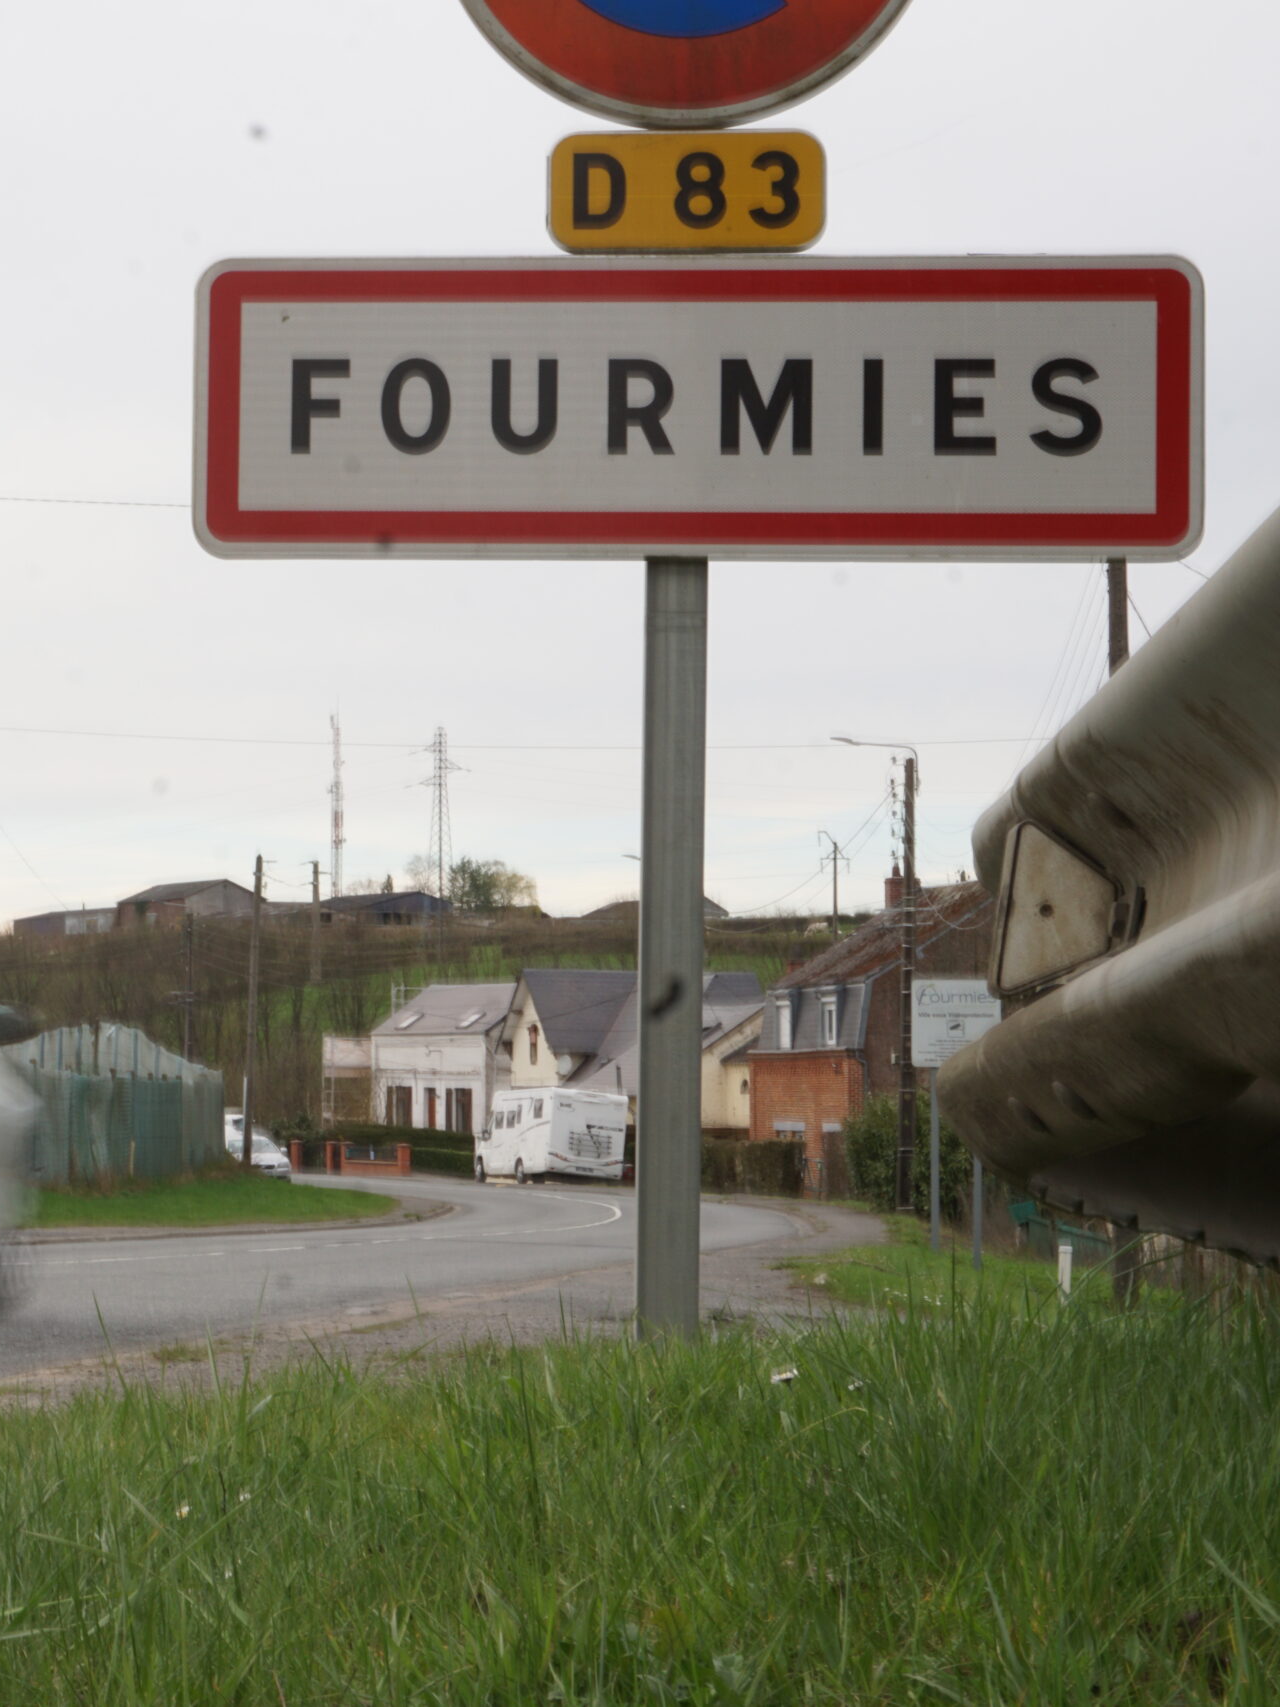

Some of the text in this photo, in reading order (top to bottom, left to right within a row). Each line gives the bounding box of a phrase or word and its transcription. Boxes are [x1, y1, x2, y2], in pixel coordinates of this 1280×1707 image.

[572, 150, 802, 230] D 83
[290, 357, 1104, 458] FOURMIES
